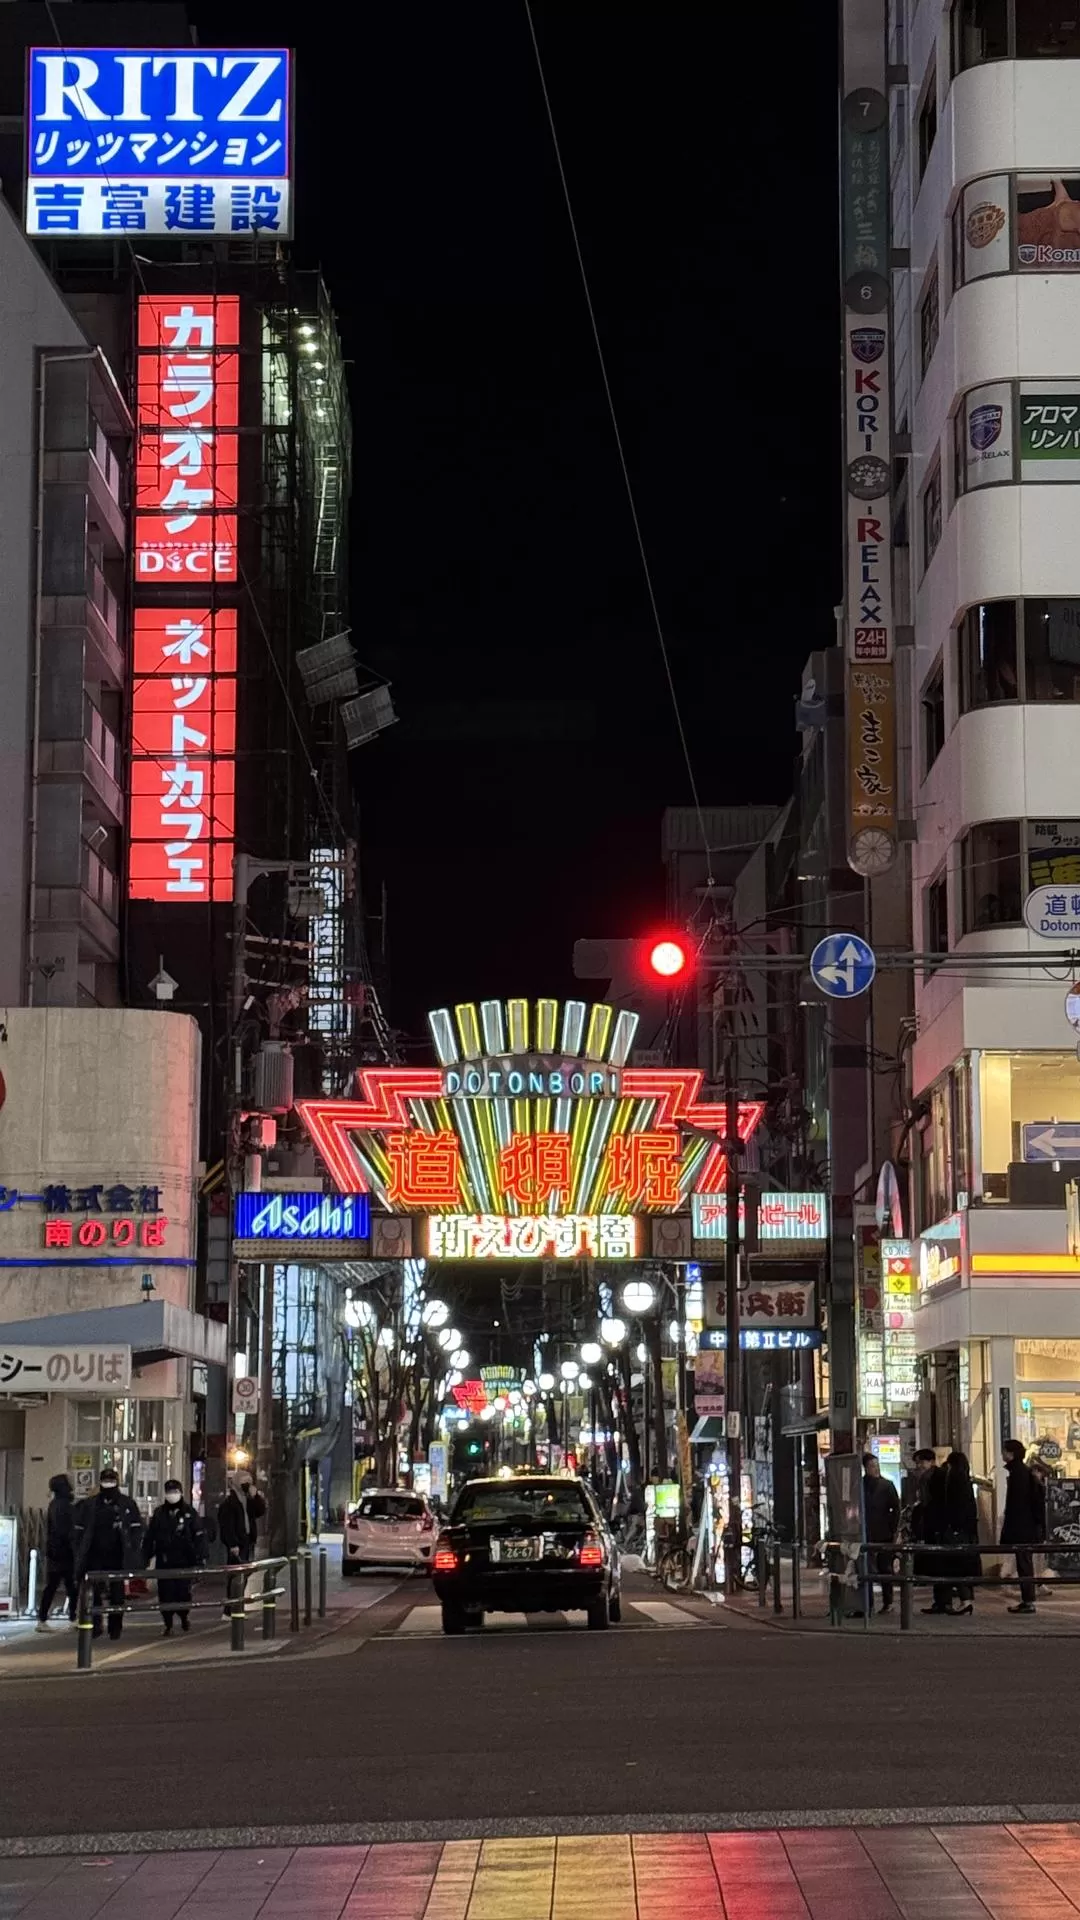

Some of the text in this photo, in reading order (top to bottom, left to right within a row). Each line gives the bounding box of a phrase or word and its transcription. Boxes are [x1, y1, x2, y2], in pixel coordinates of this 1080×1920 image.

[36, 56, 282, 121] RITZ
[859, 102, 871, 117] 7
[36, 131, 282, 166] リッツマンション
[34, 184, 282, 231] 吉富建設
[860, 286, 872, 300] 6
[161, 306, 213, 535] カラオケ
[1023, 406, 1079, 424] アロマ
[856, 630, 885, 645] 24H
[160, 619, 210, 892] ネットカフェ
[446, 1072, 616, 1094] DOTONBORI
[387, 1131, 681, 1205] 道頓堀
[44, 1215, 170, 1248] 南のりば
[251, 1194, 355, 1235] Asahi
